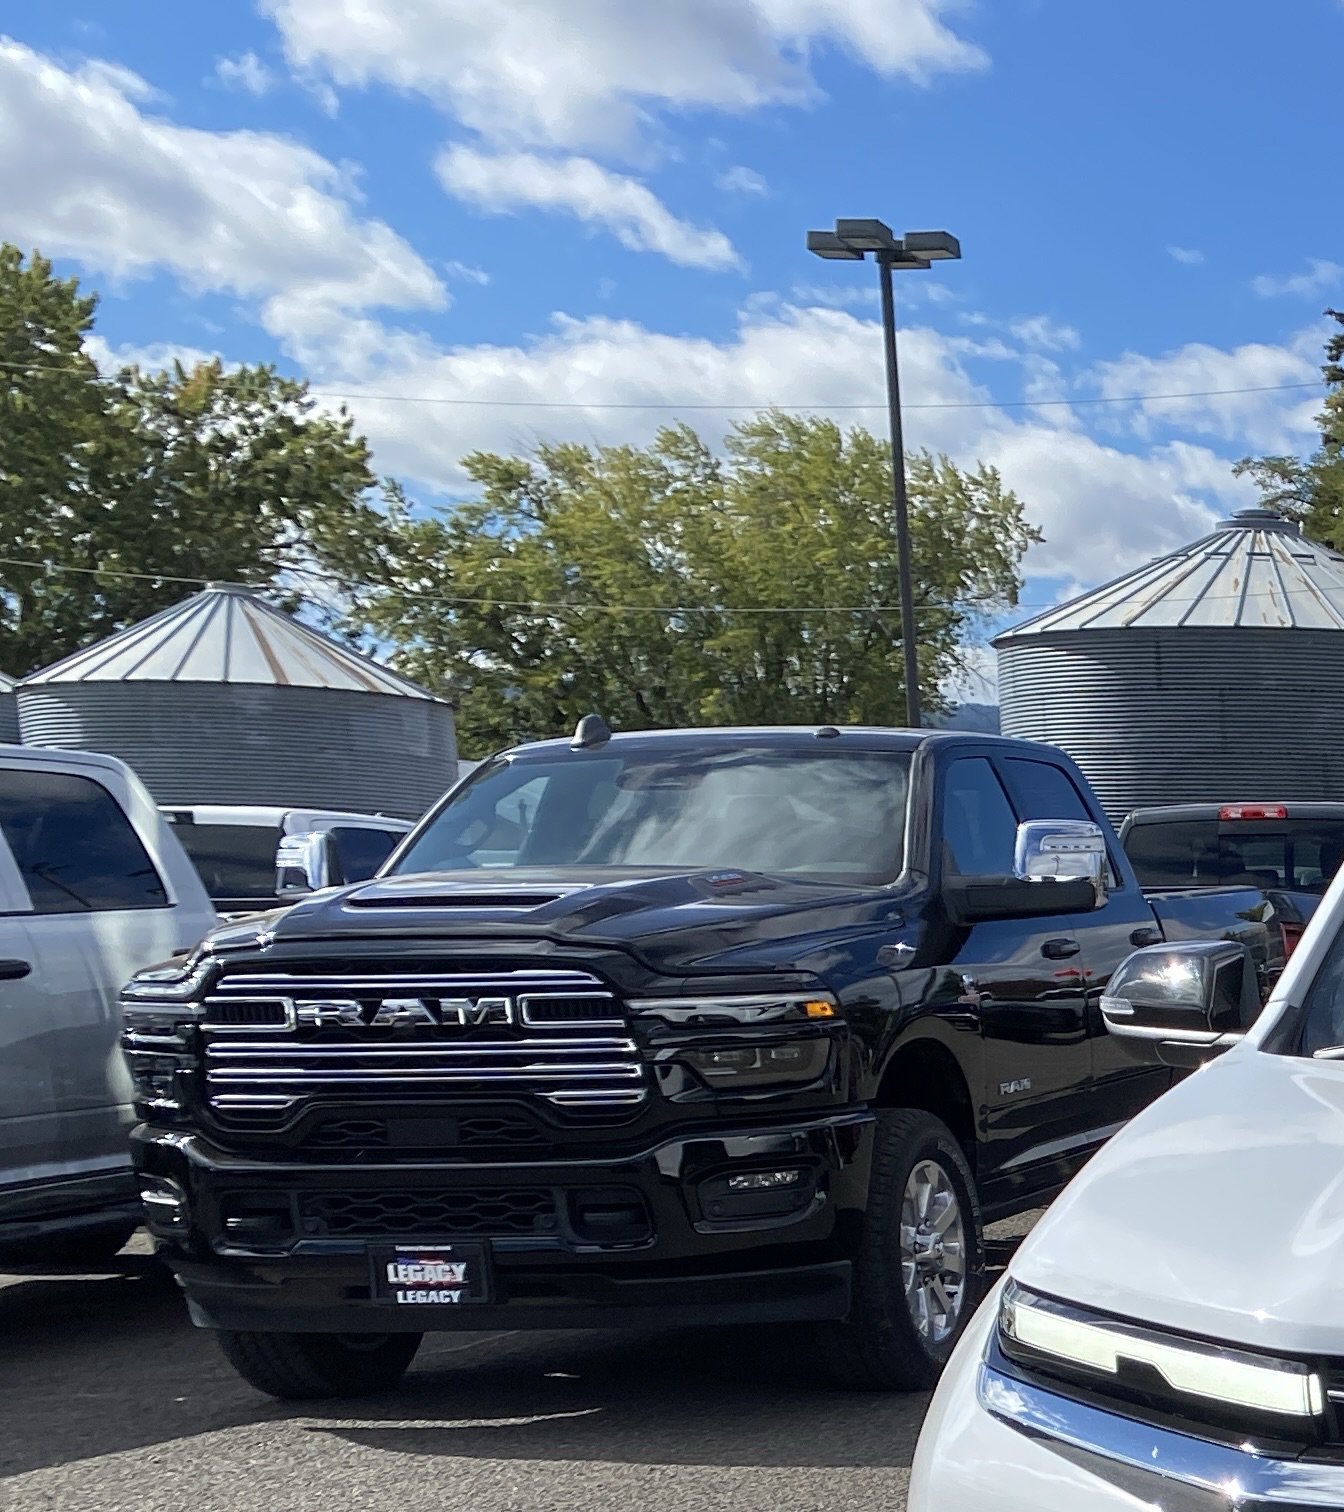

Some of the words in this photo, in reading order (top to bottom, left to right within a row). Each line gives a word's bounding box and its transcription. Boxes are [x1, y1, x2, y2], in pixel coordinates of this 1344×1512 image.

[296, 998, 513, 1027] RAM
[387, 1262, 466, 1284] LEGACY
[397, 1291, 461, 1303] LEGACY
